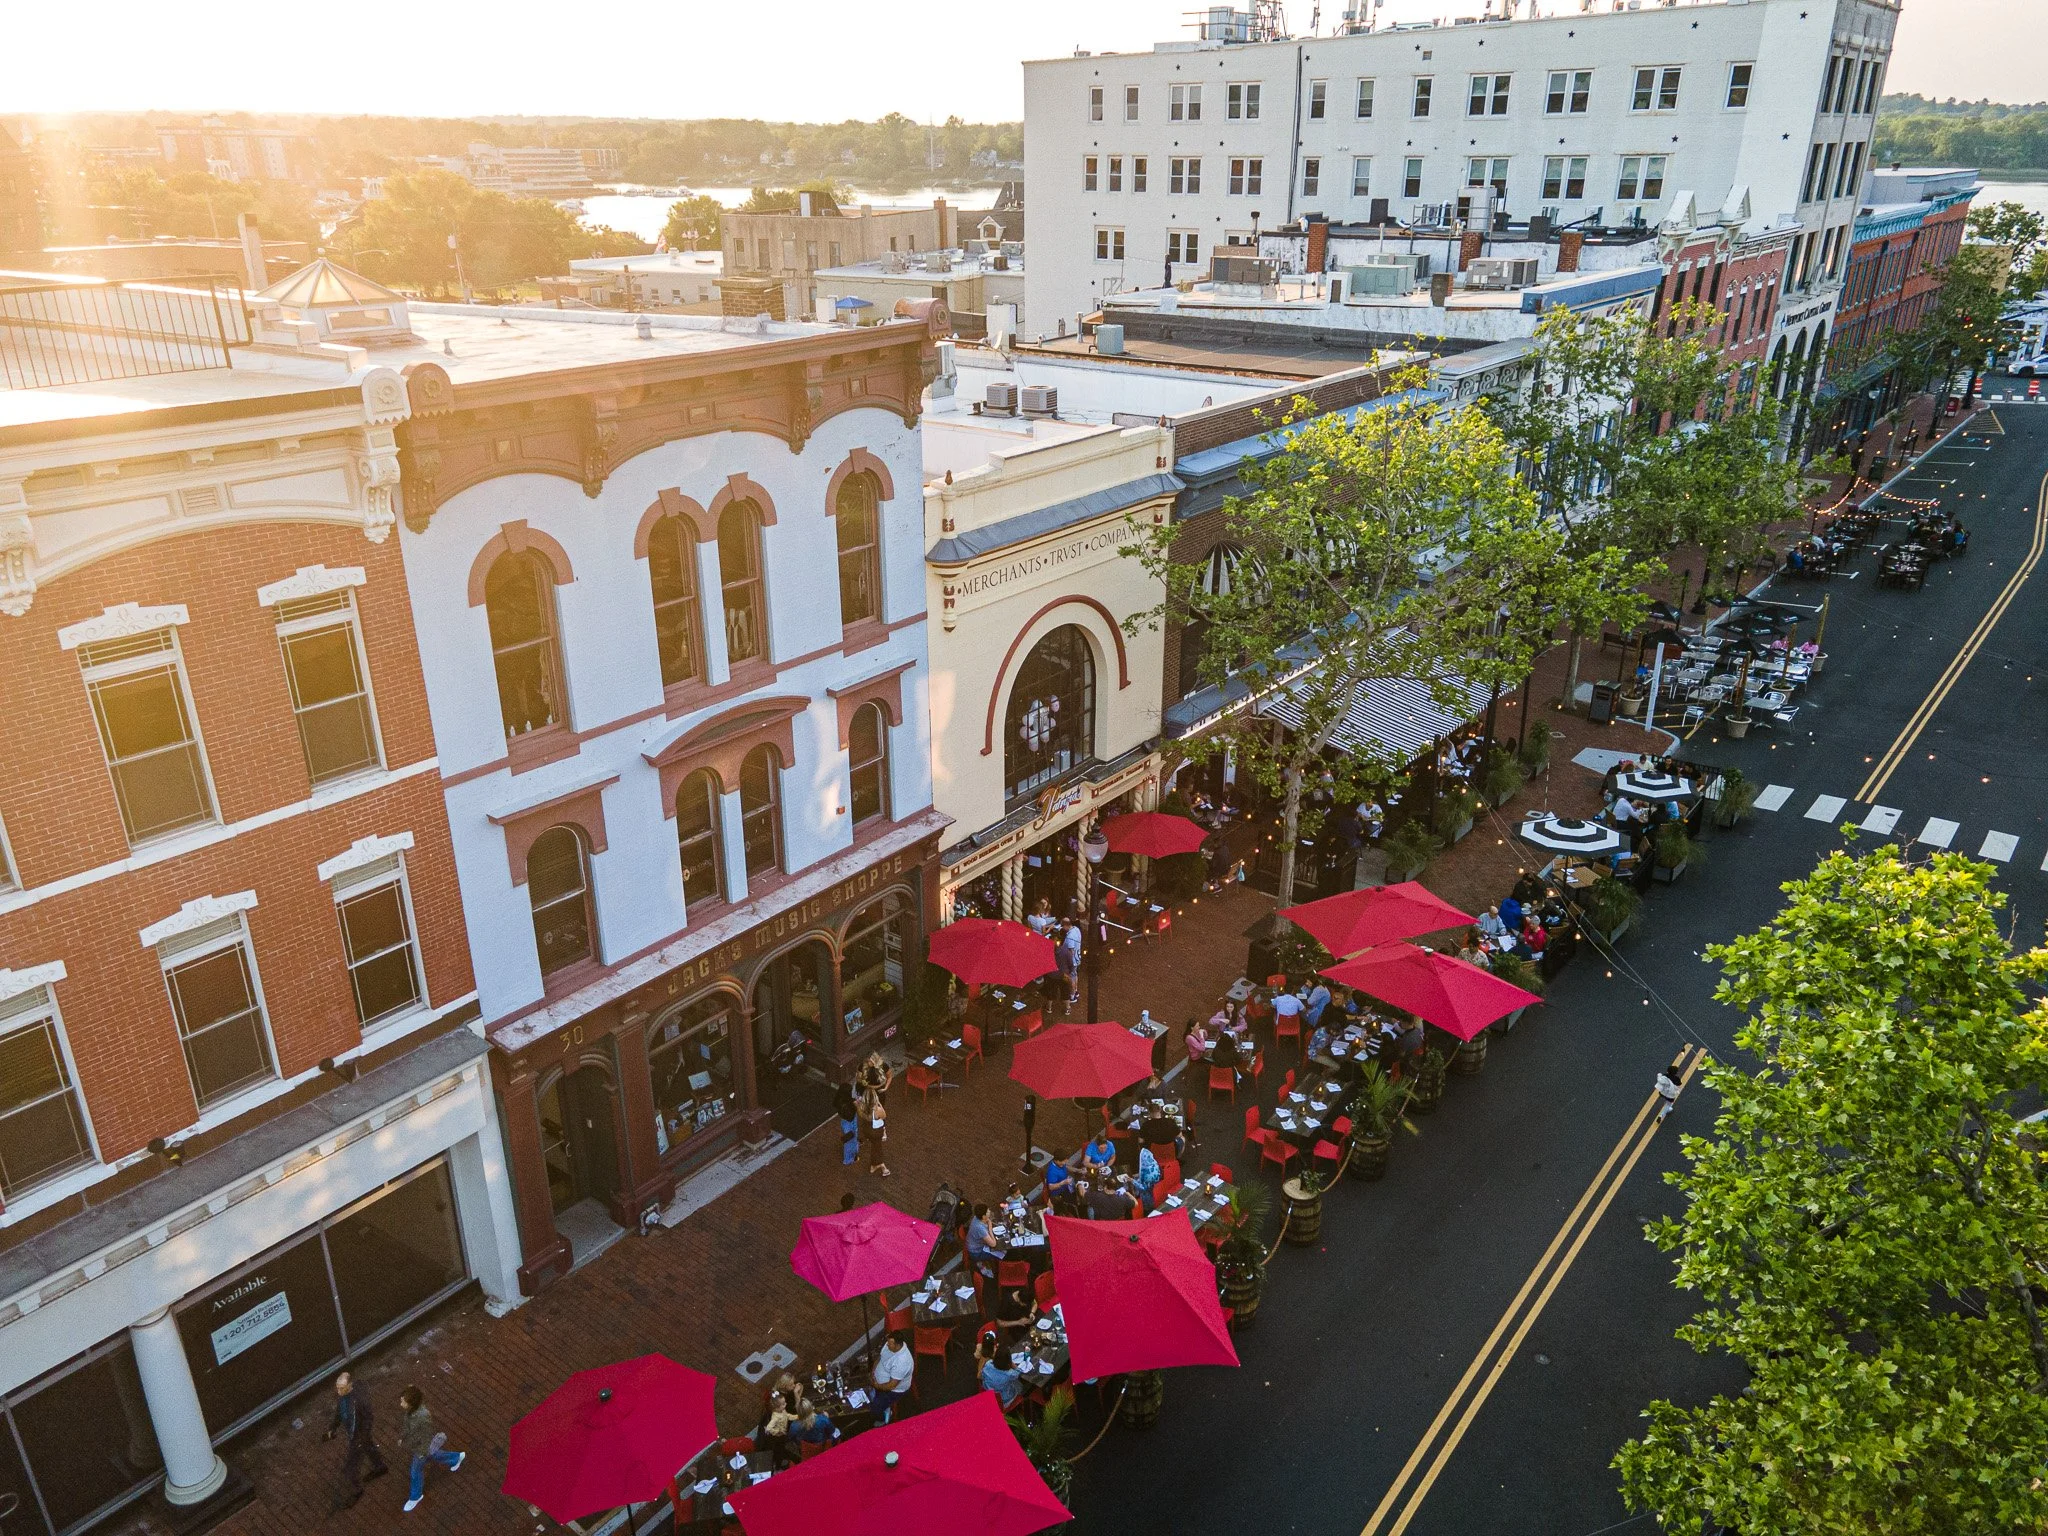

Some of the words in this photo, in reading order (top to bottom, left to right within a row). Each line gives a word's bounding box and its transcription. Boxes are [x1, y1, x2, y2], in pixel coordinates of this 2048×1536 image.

[962, 557, 1041, 597] MERCHANTS
[754, 898, 822, 949] MUSIC
[831, 855, 903, 906] SHOPPE
[559, 1025, 584, 1053] 30
[212, 1275, 268, 1313] Available
[229, 1323, 246, 1338] 201
[246, 1314, 261, 1327] 712
